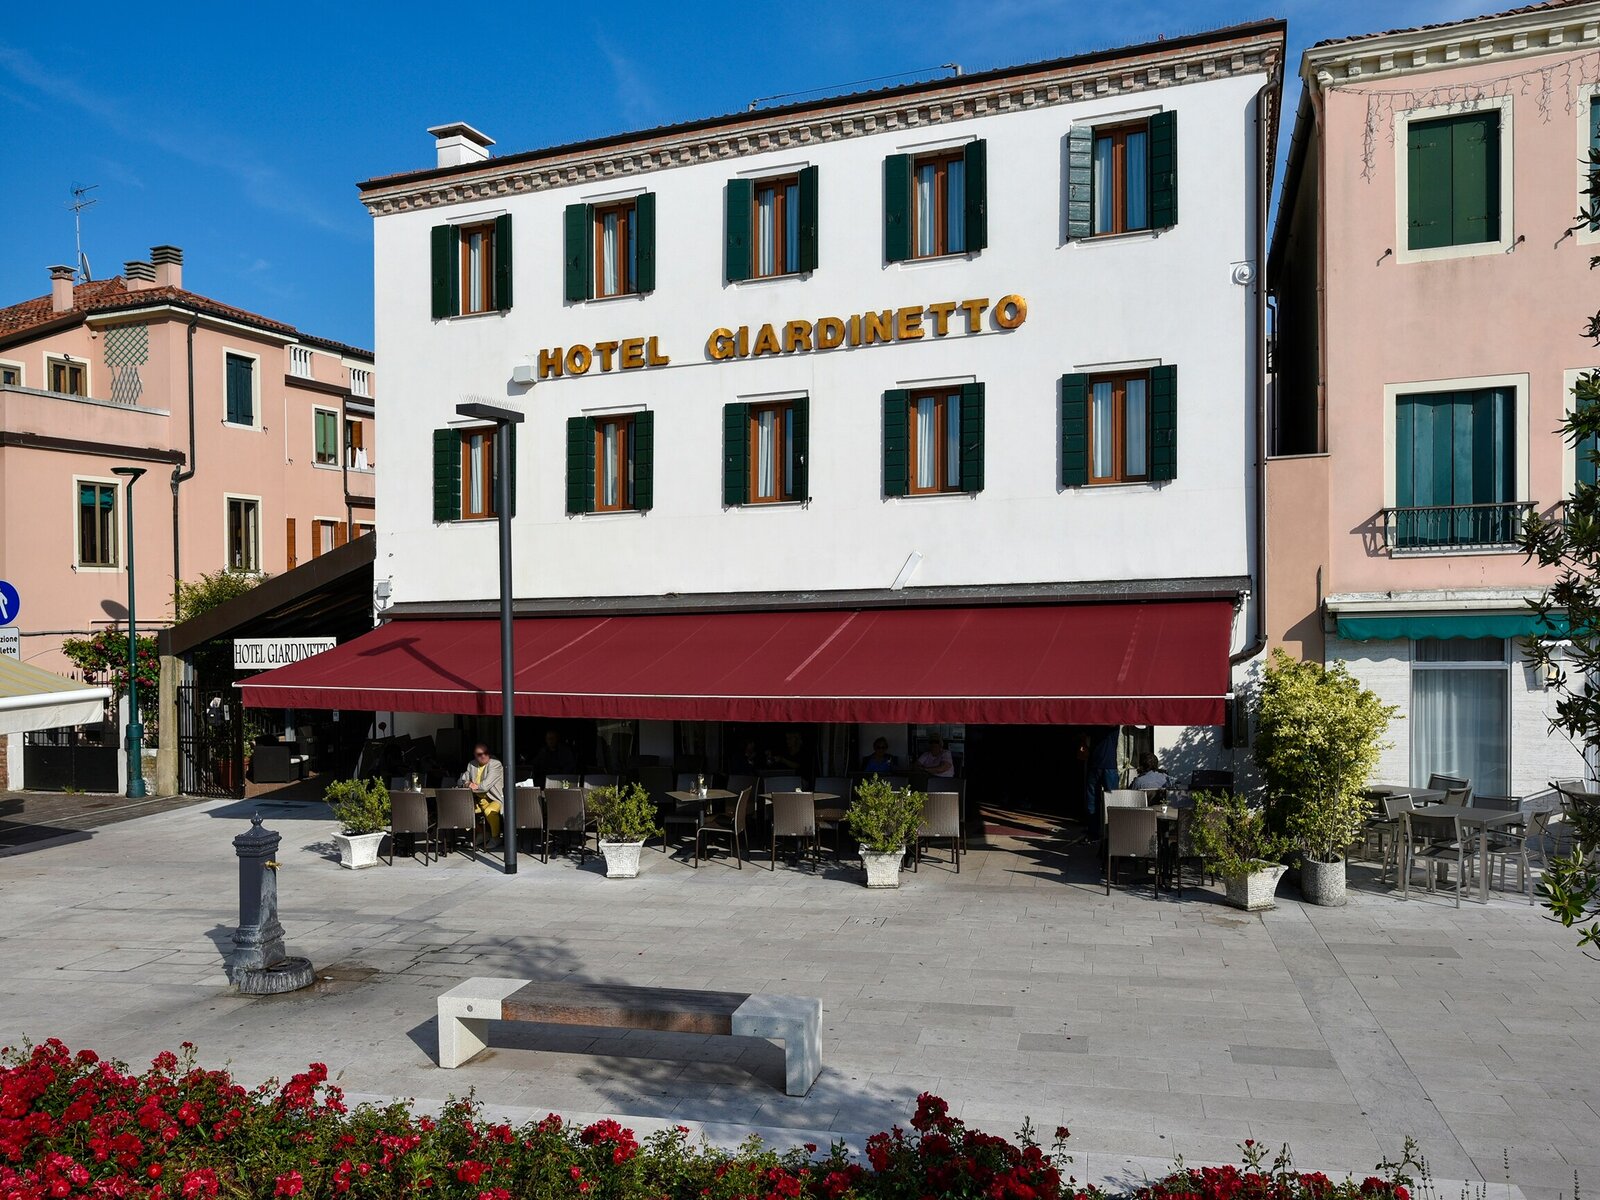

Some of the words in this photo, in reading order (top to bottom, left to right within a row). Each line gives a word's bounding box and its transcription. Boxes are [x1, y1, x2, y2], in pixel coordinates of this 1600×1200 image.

[539, 336, 671, 378] HOTEL
[707, 294, 1028, 360] GIARDINETTO
[0, 635, 18, 643] zione
[234, 644, 266, 664] HOTEL
